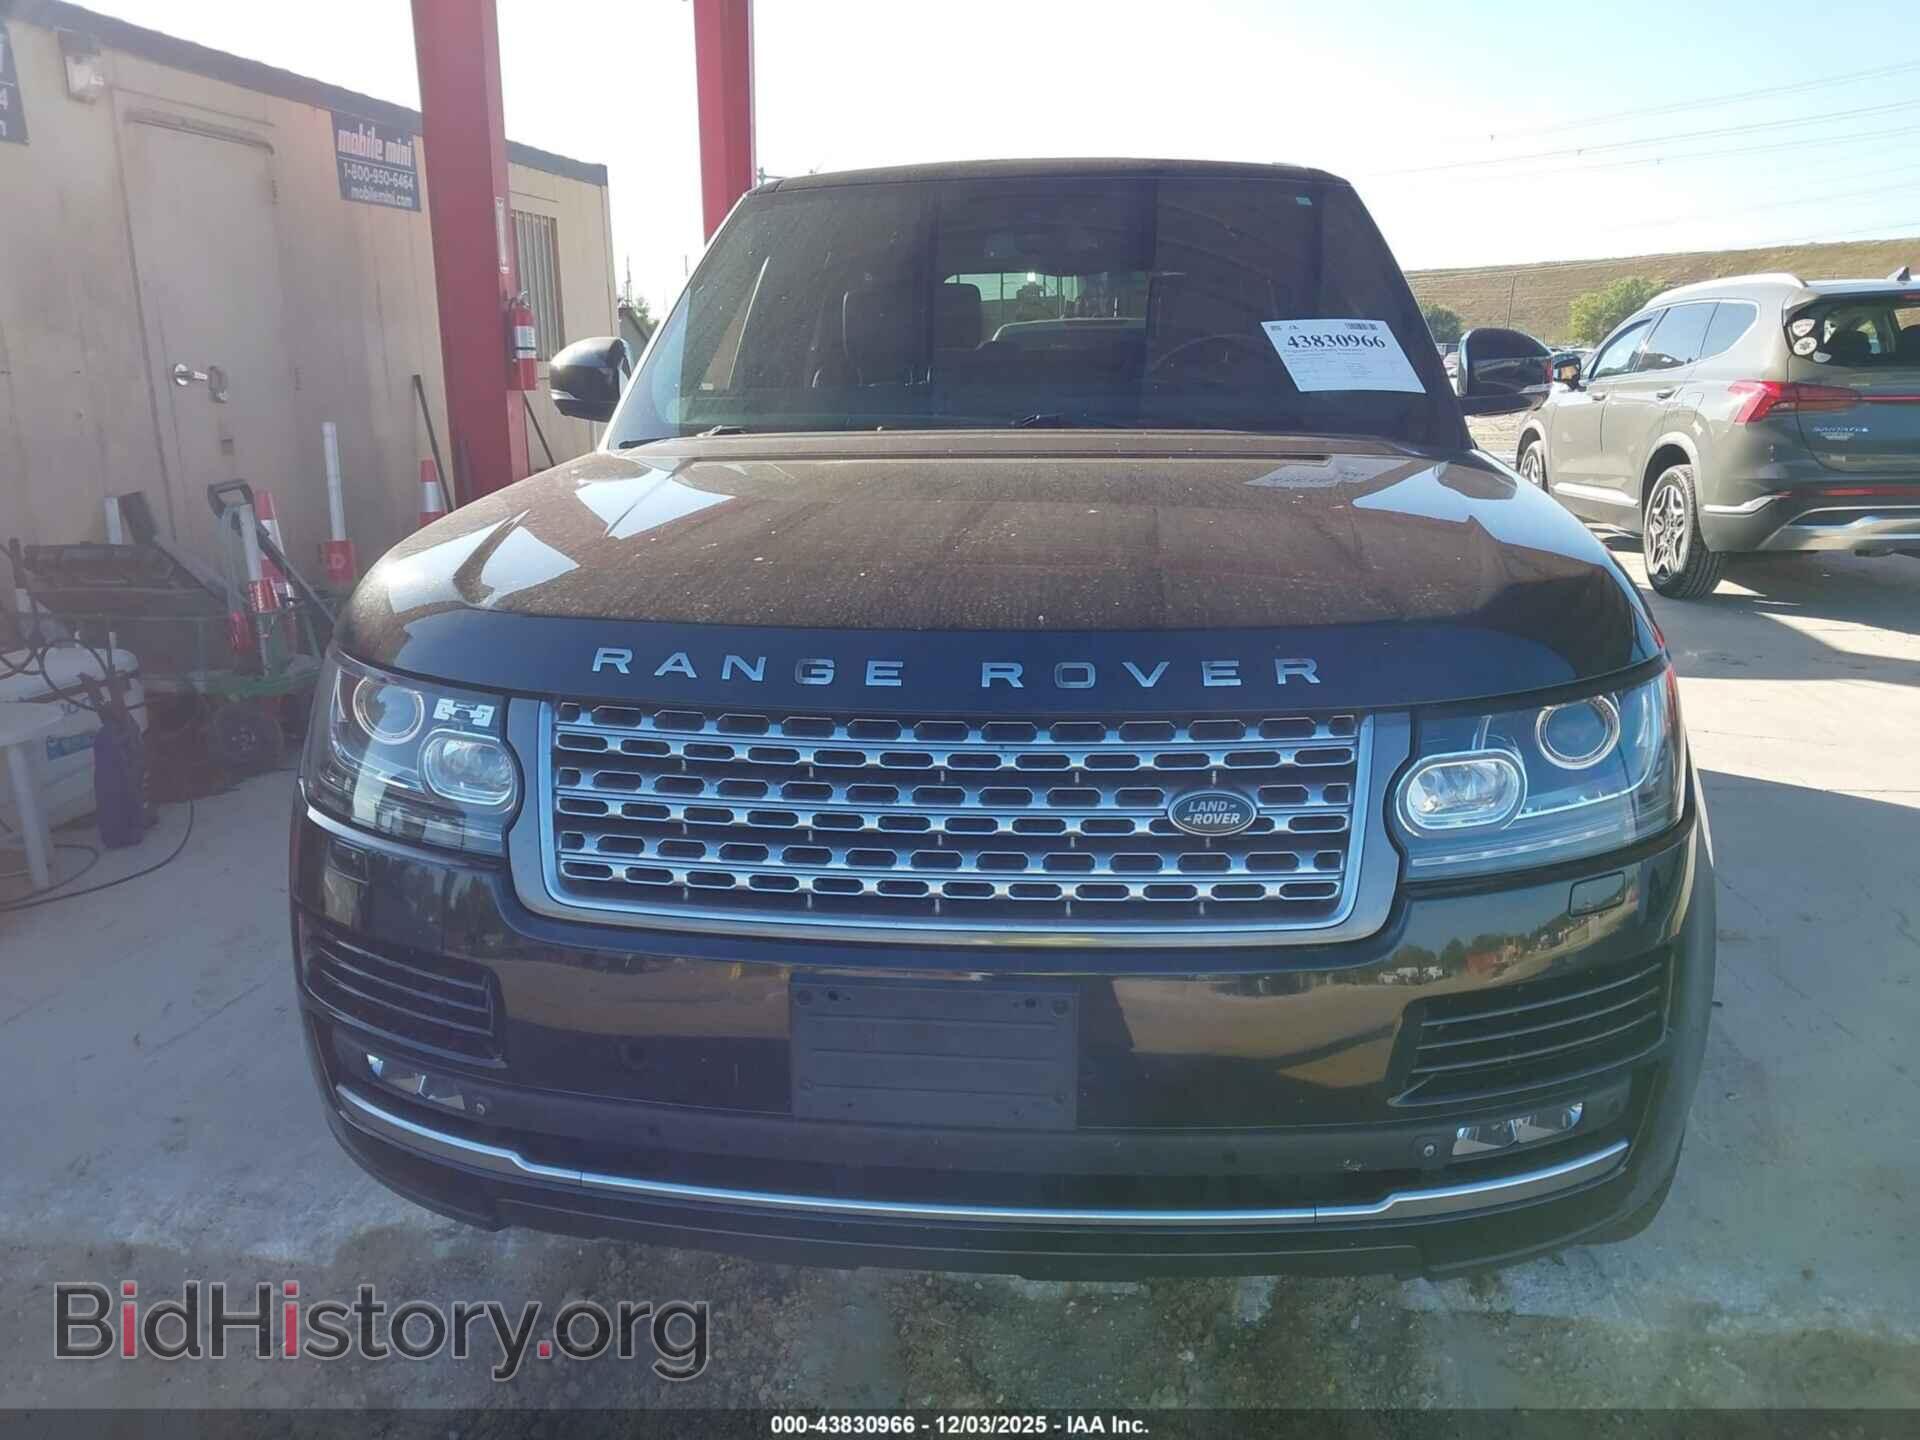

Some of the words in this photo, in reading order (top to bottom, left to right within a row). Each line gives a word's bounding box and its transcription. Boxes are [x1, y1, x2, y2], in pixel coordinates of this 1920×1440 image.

[338, 123, 384, 161] mobile
[385, 138, 412, 167] mini
[1287, 334, 1386, 348] 43830966
[592, 648, 903, 686] RANGE
[981, 658, 1321, 688] ROVER
